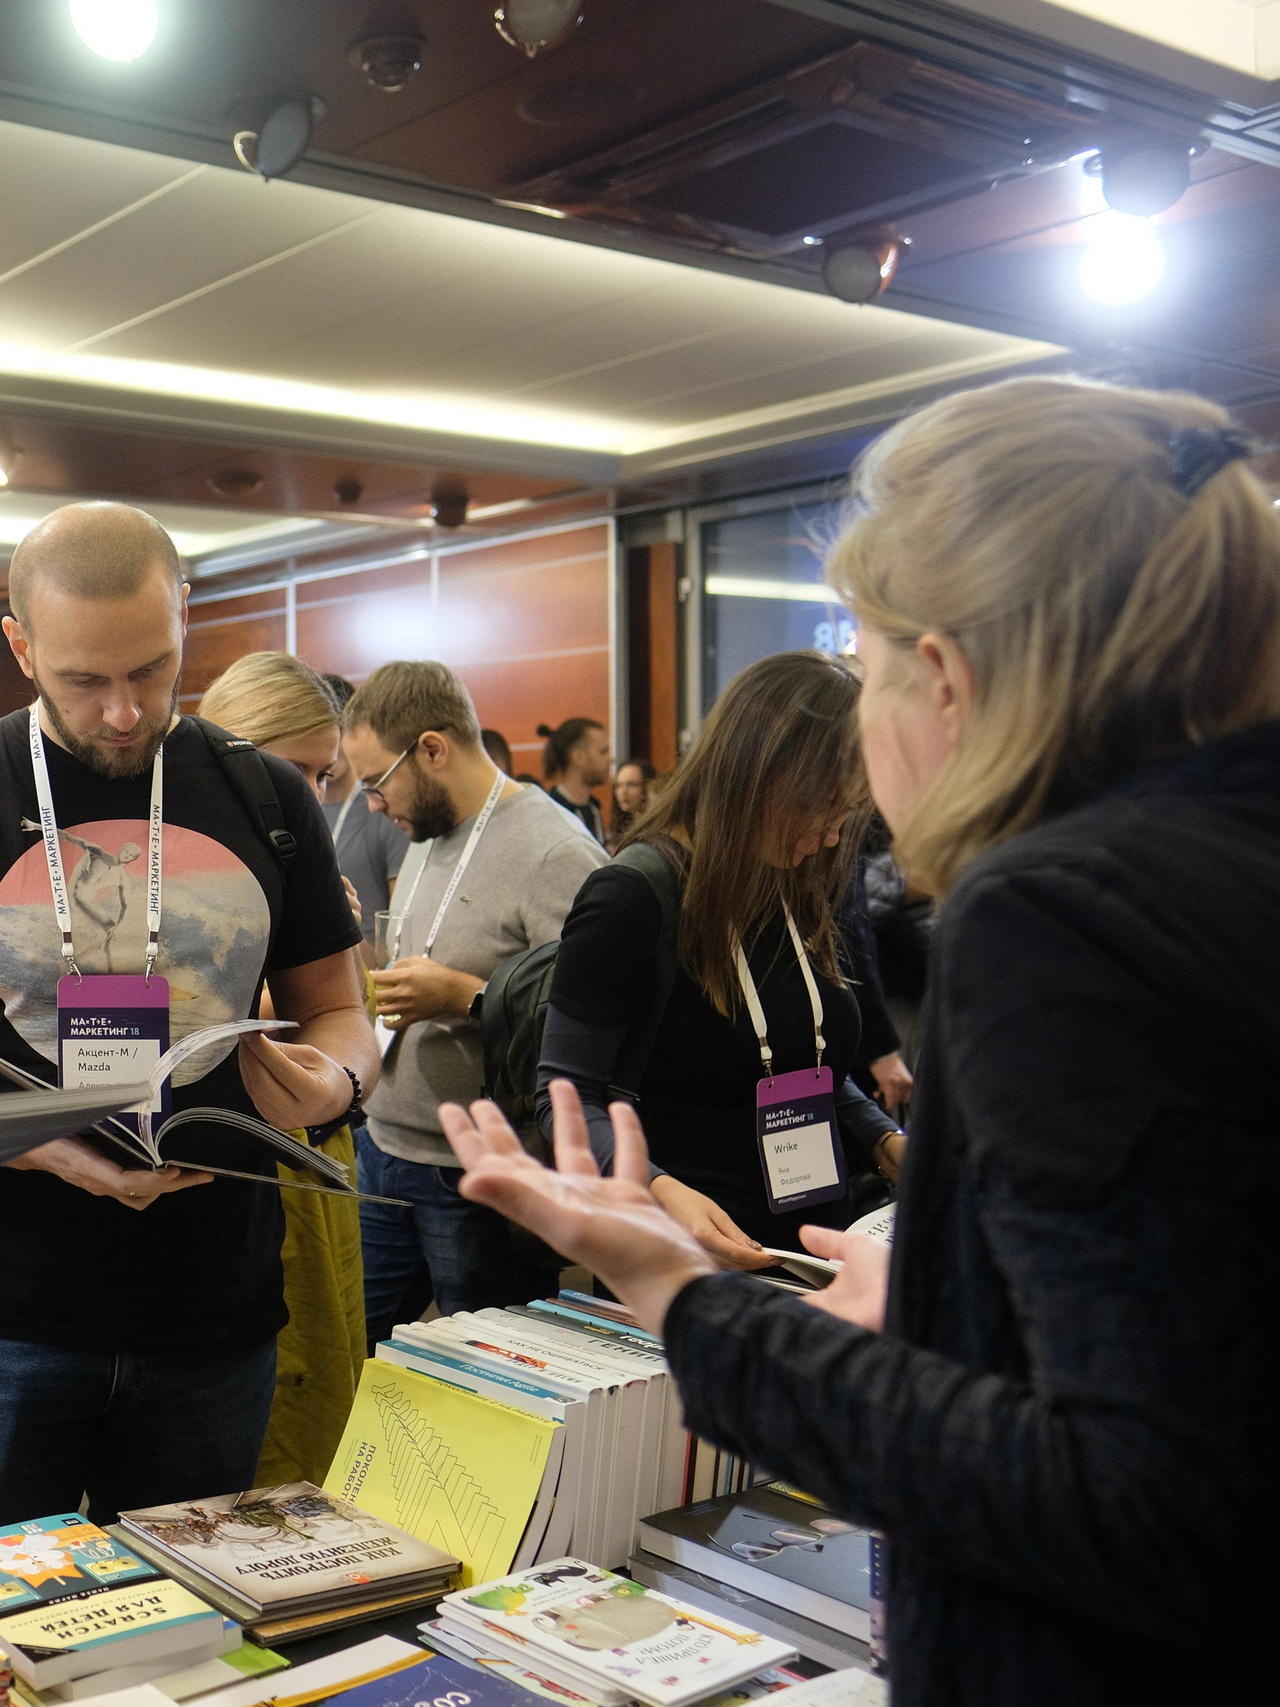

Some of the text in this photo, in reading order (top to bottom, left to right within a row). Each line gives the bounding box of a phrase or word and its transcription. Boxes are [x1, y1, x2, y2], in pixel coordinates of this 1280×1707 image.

[41, 806, 59, 868] МАРКЕТИНГ
[150, 851, 160, 915] МАРКЕТИНГ
[70, 1027, 140, 1036] МАРКЕТИНГ 18
[77, 1048, 129, 1059] Акцент-М
[78, 1061, 111, 1072] Mazda
[766, 1112, 814, 1130] МАРКЕТИНГ 18
[774, 1142, 798, 1154] Wrike
[506, 1339, 527, 1349] КАК
[508, 1379, 539, 1392] Agile
[433, 1380, 489, 1403] ПОКОЛЕНИЕ
[497, 1402, 512, 1410] НА
[512, 1408, 551, 1424] РАБОТЕ
[357, 1441, 368, 1462] НА
[339, 1462, 363, 1503] РАБОТ
[349, 1445, 377, 1506] ПОКОЛЕН
[299, 1536, 399, 1563] ЖЕЛЕЗНУЮ
[368, 1547, 402, 1561] КАК
[235, 1553, 301, 1575] ДОРОГУ
[259, 1555, 365, 1581] ПОСТРОИТЬ
[40, 1596, 162, 1634] ДЛЯ ДЕТЕЙ
[57, 1607, 167, 1640] SCRATCH
